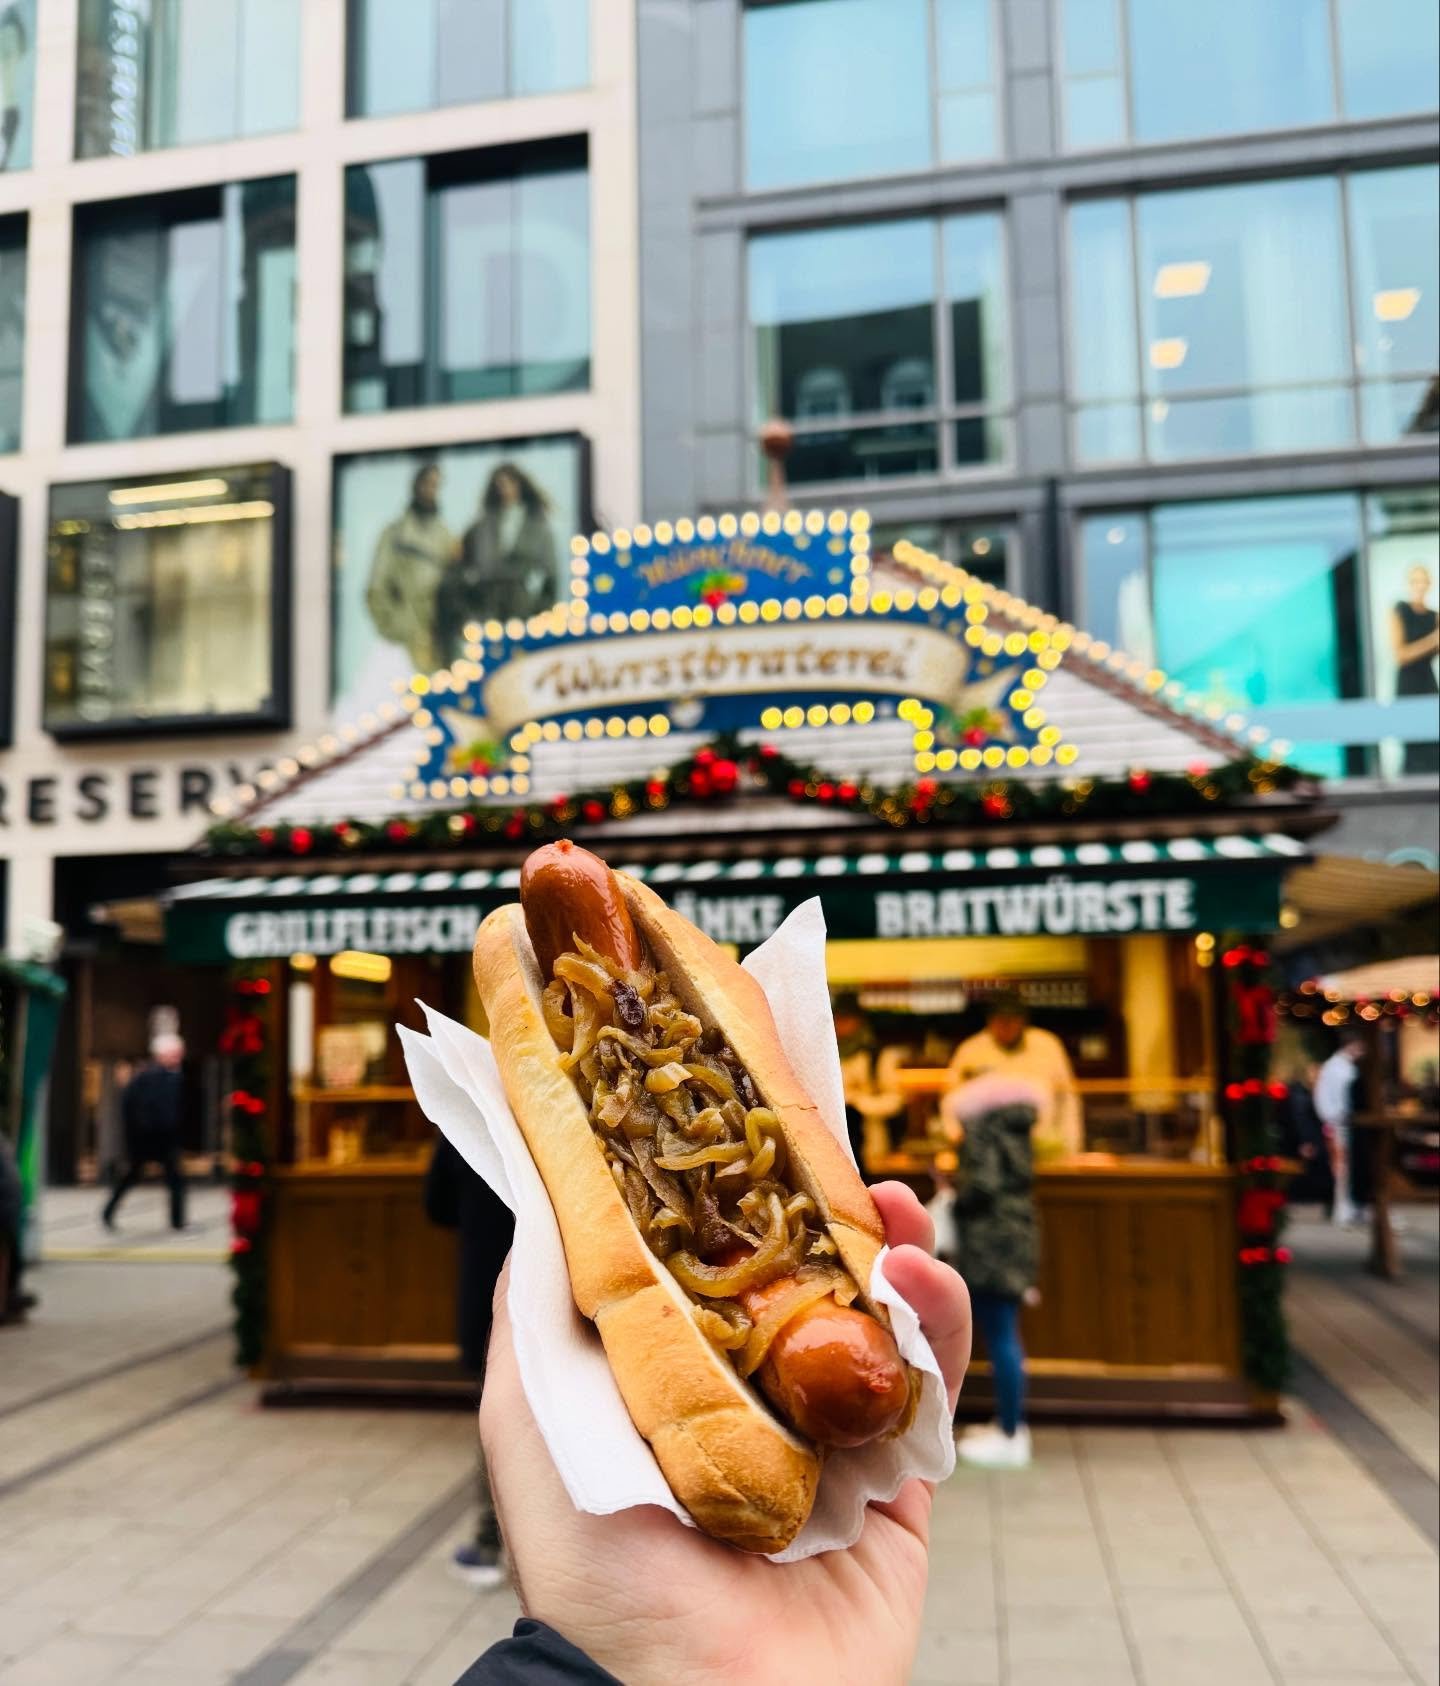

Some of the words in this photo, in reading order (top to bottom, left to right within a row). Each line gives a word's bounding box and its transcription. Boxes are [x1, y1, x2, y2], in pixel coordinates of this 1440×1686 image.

[225, 905, 480, 958] GRILLFLEISCH
[671, 889, 786, 942] ÄNKE
[874, 875, 1196, 938] BRATWÜRSTE
